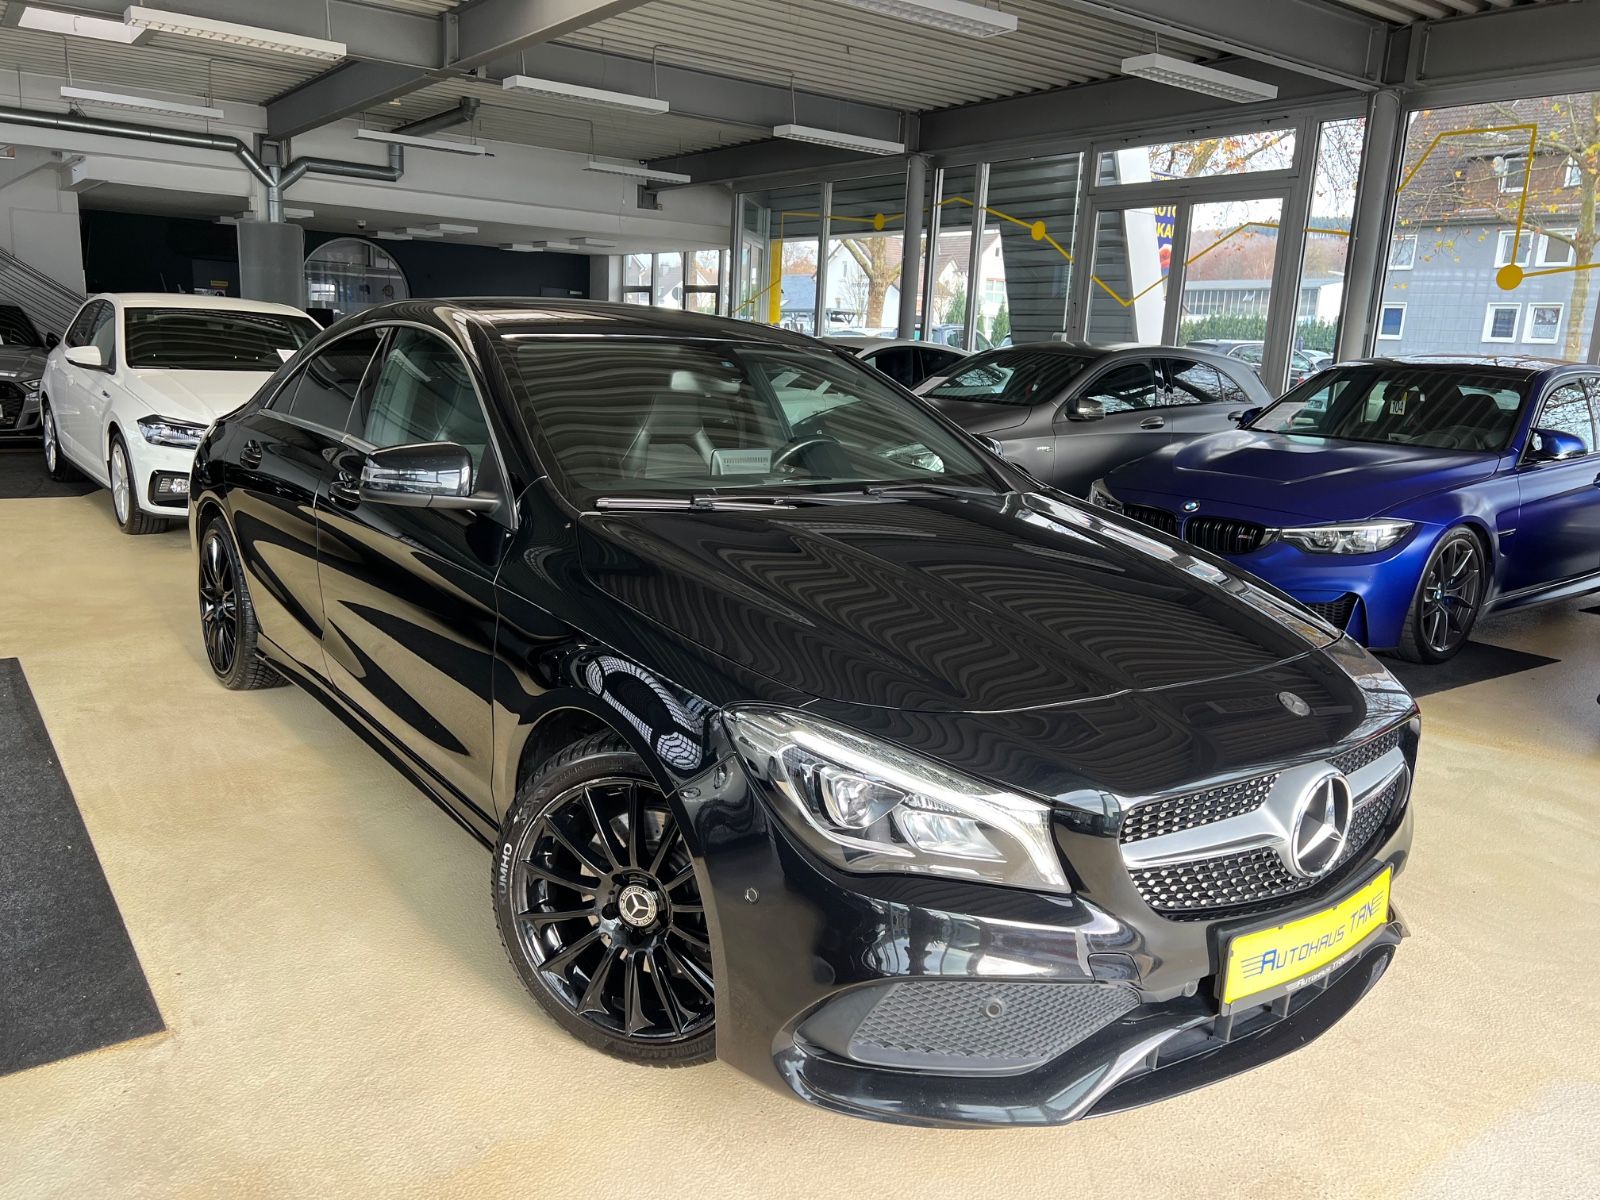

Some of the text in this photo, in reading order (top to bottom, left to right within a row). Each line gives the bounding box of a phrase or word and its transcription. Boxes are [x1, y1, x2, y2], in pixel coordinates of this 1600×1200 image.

[1392, 401, 1404, 413] 104
[1260, 903, 1373, 974] AUTOHAUS TAN
